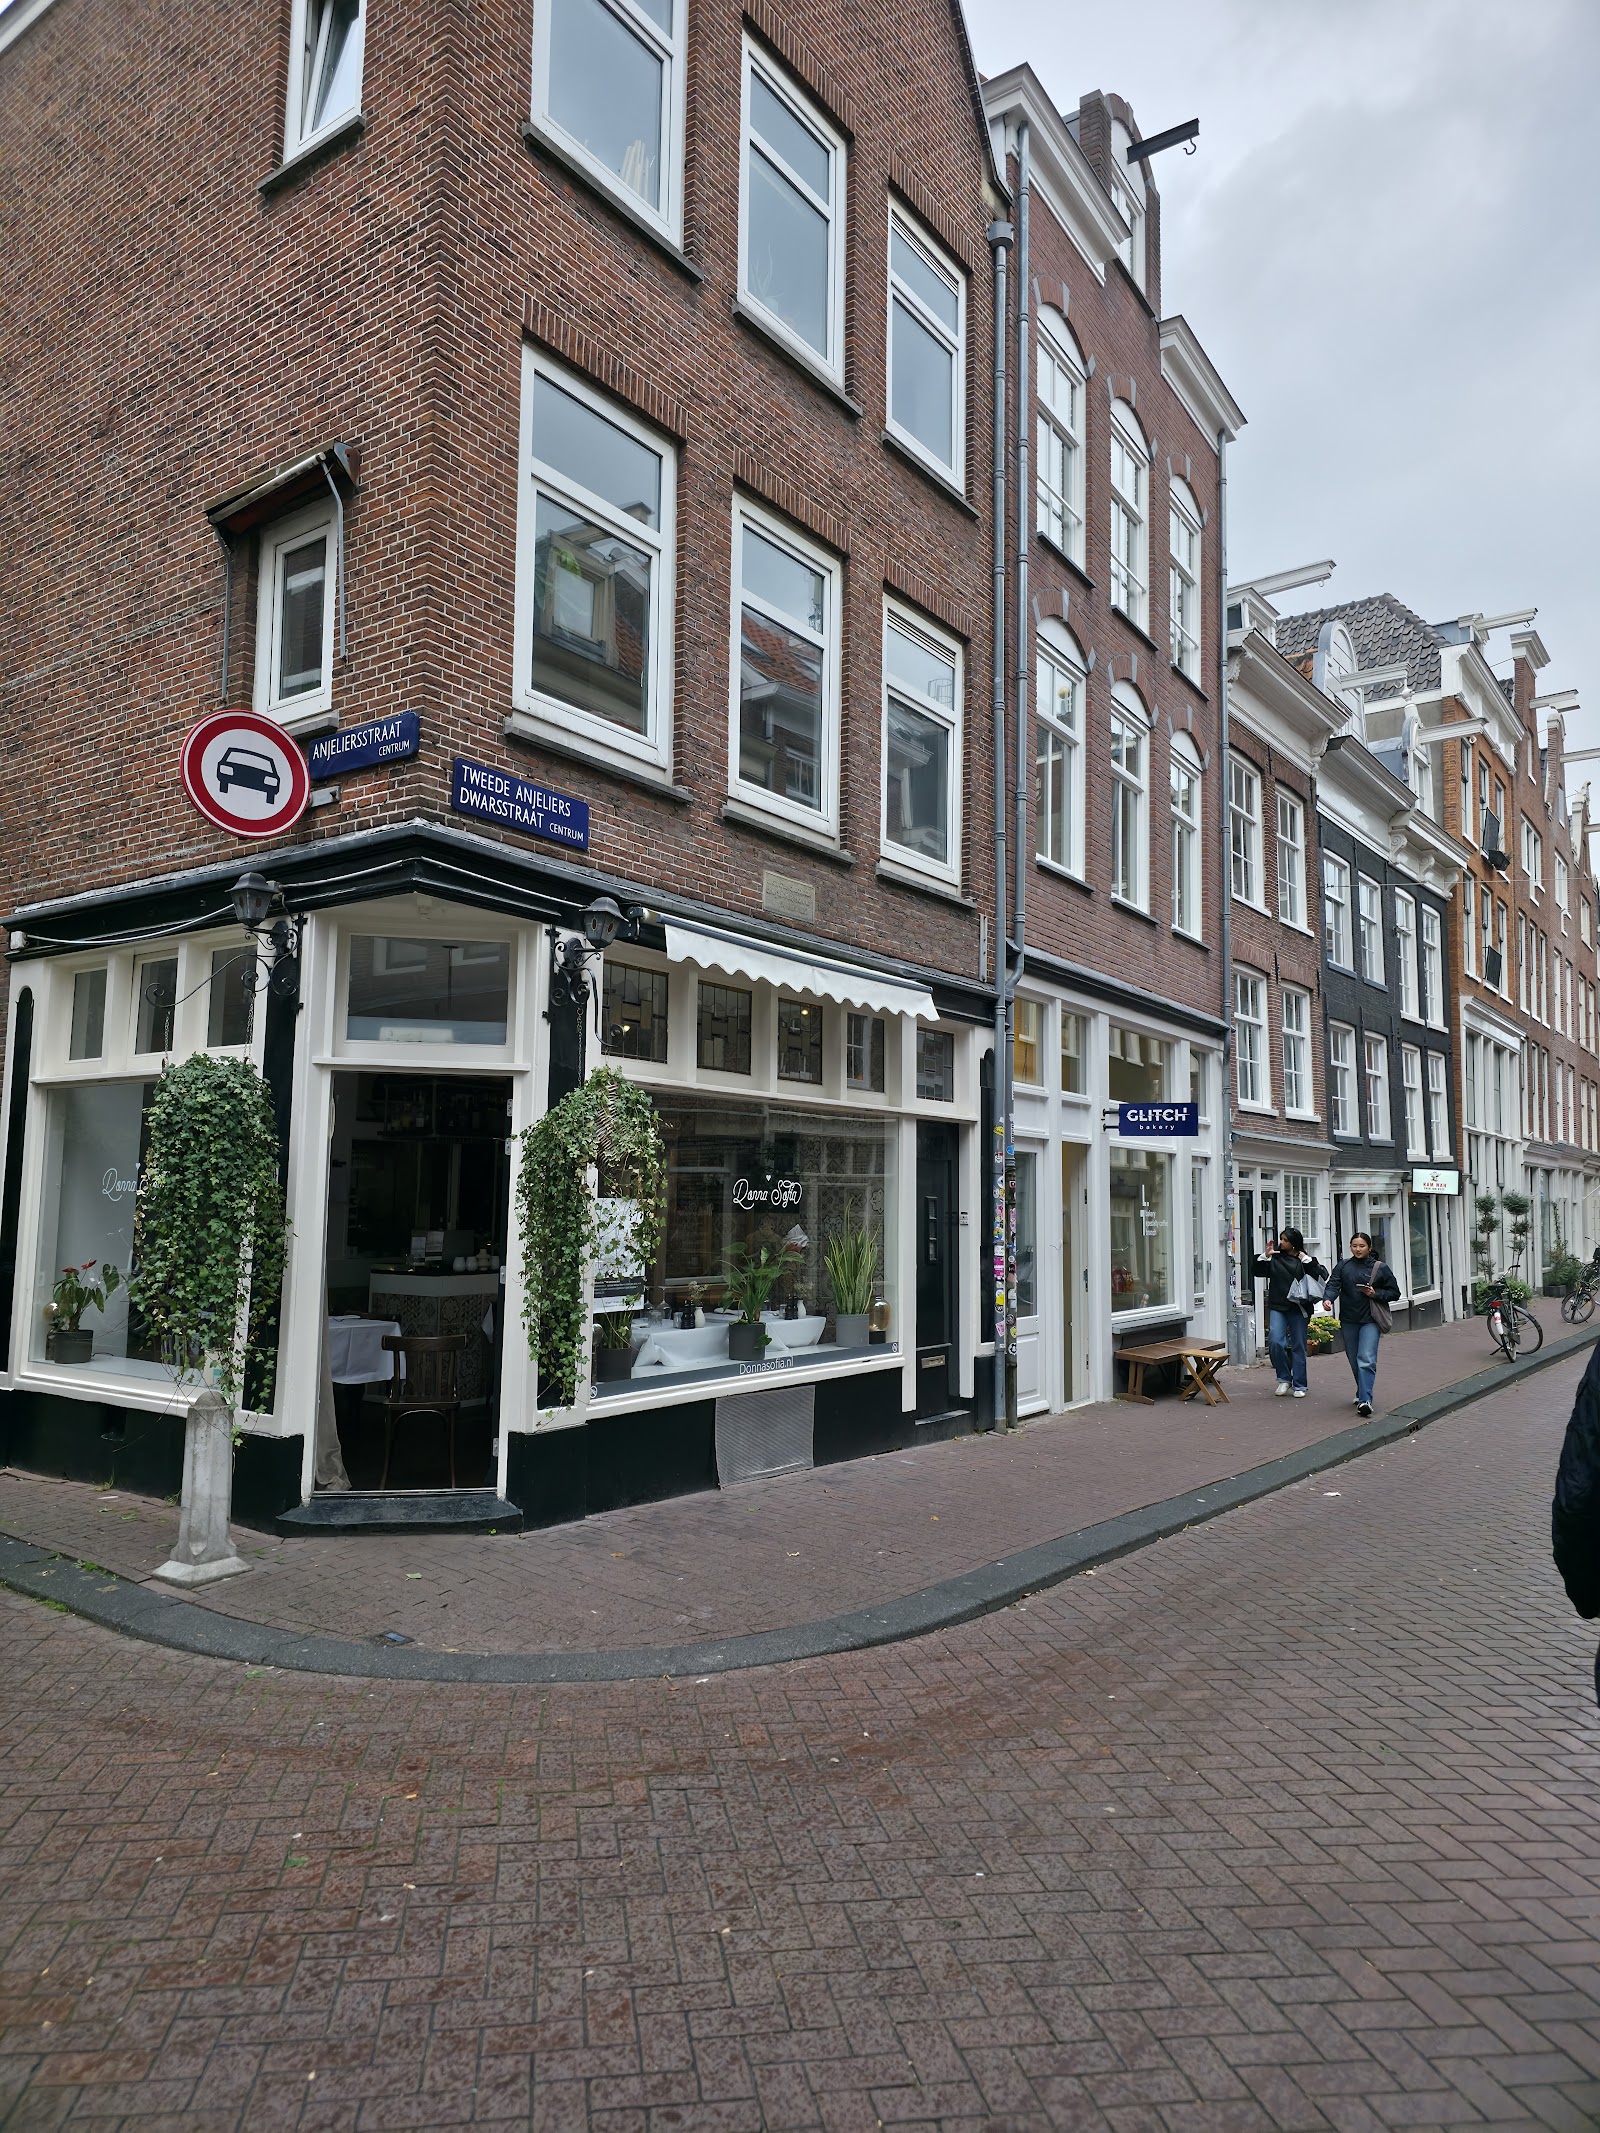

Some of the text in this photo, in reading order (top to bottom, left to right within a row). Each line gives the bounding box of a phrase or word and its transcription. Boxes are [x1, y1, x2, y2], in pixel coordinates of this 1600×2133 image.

[312, 720, 403, 762] ANJELIERSSTRAAT
[378, 739, 411, 757] CENTRUM
[461, 764, 572, 818] TWEEDE ANJELIERS
[459, 786, 584, 842] DWARSSTRAAT CENTRUM
[1126, 1107, 1190, 1122] GLITCH
[101, 1167, 138, 1202] Donna
[732, 1178, 803, 1210] Donna Sofia
[739, 1356, 794, 1375] Donnasofia.nl
